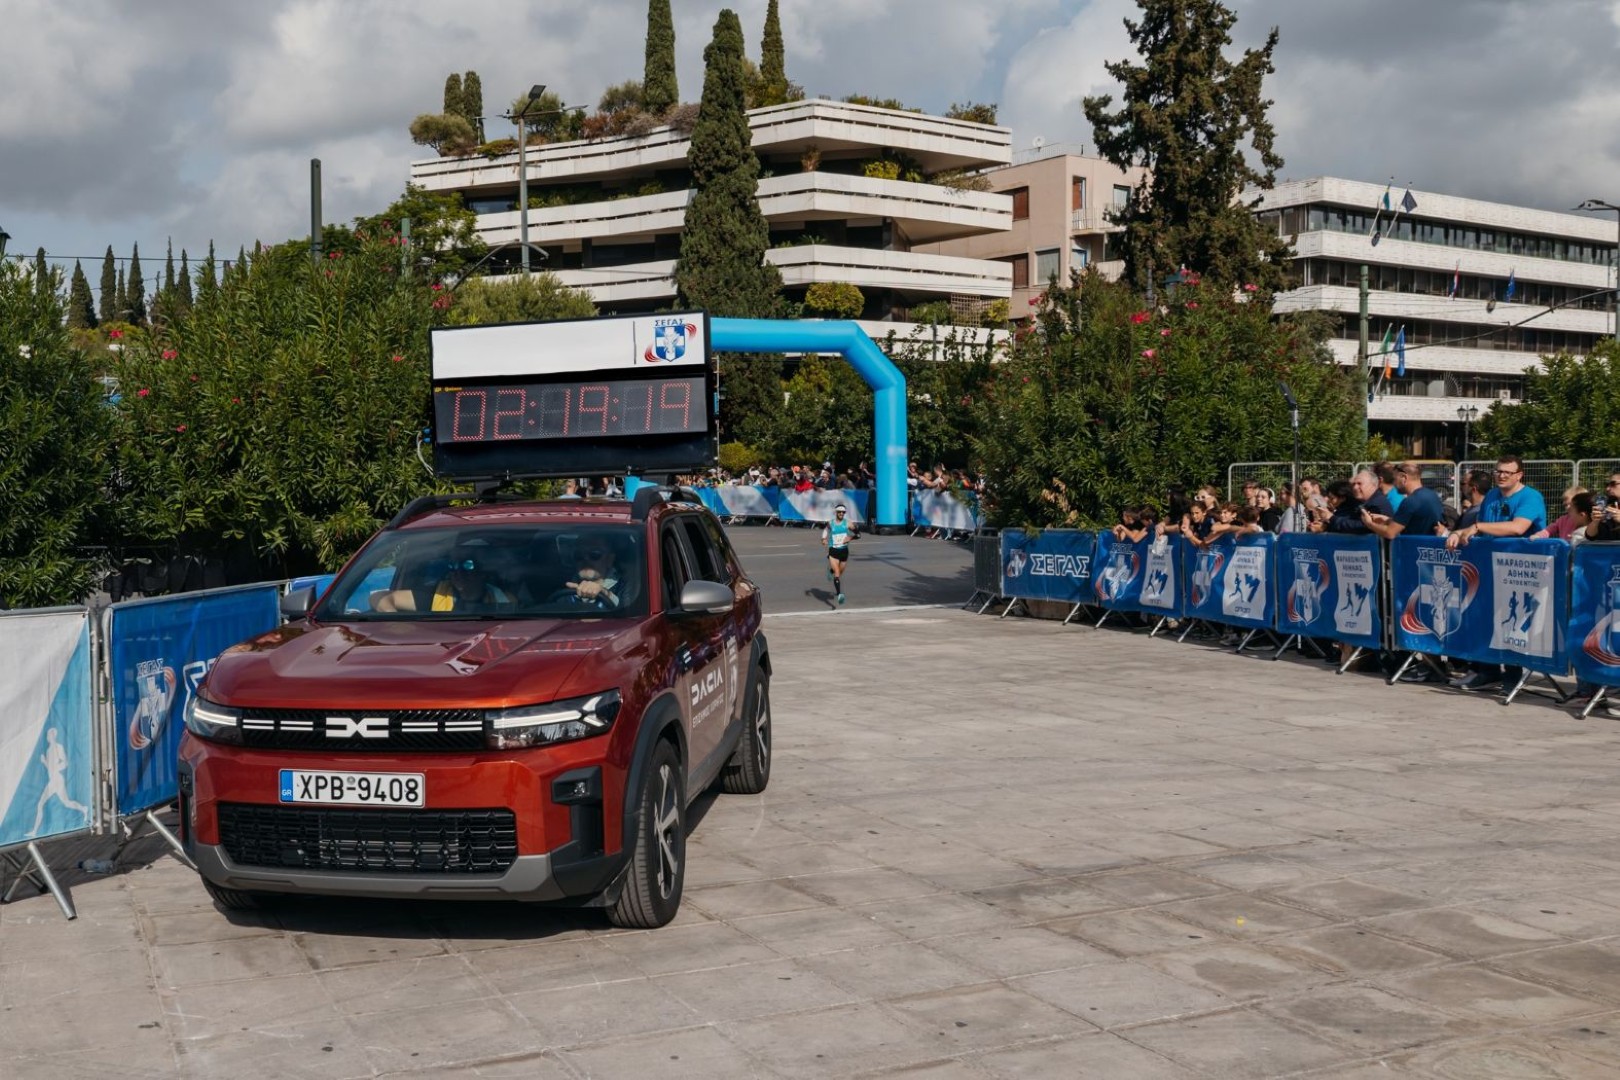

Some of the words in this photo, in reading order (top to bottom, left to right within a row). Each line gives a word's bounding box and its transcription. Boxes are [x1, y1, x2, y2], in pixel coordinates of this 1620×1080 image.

[654, 318, 684, 327] ΣΕΓΑΣ
[453, 382, 690, 441] 02:19:19
[1030, 553, 1090, 578] ΣΕΓΑΣ
[1416, 547, 1462, 565] ΣΕΓΑΣ
[691, 666, 724, 706] DACIA
[300, 774, 419, 803] XPB-9408
